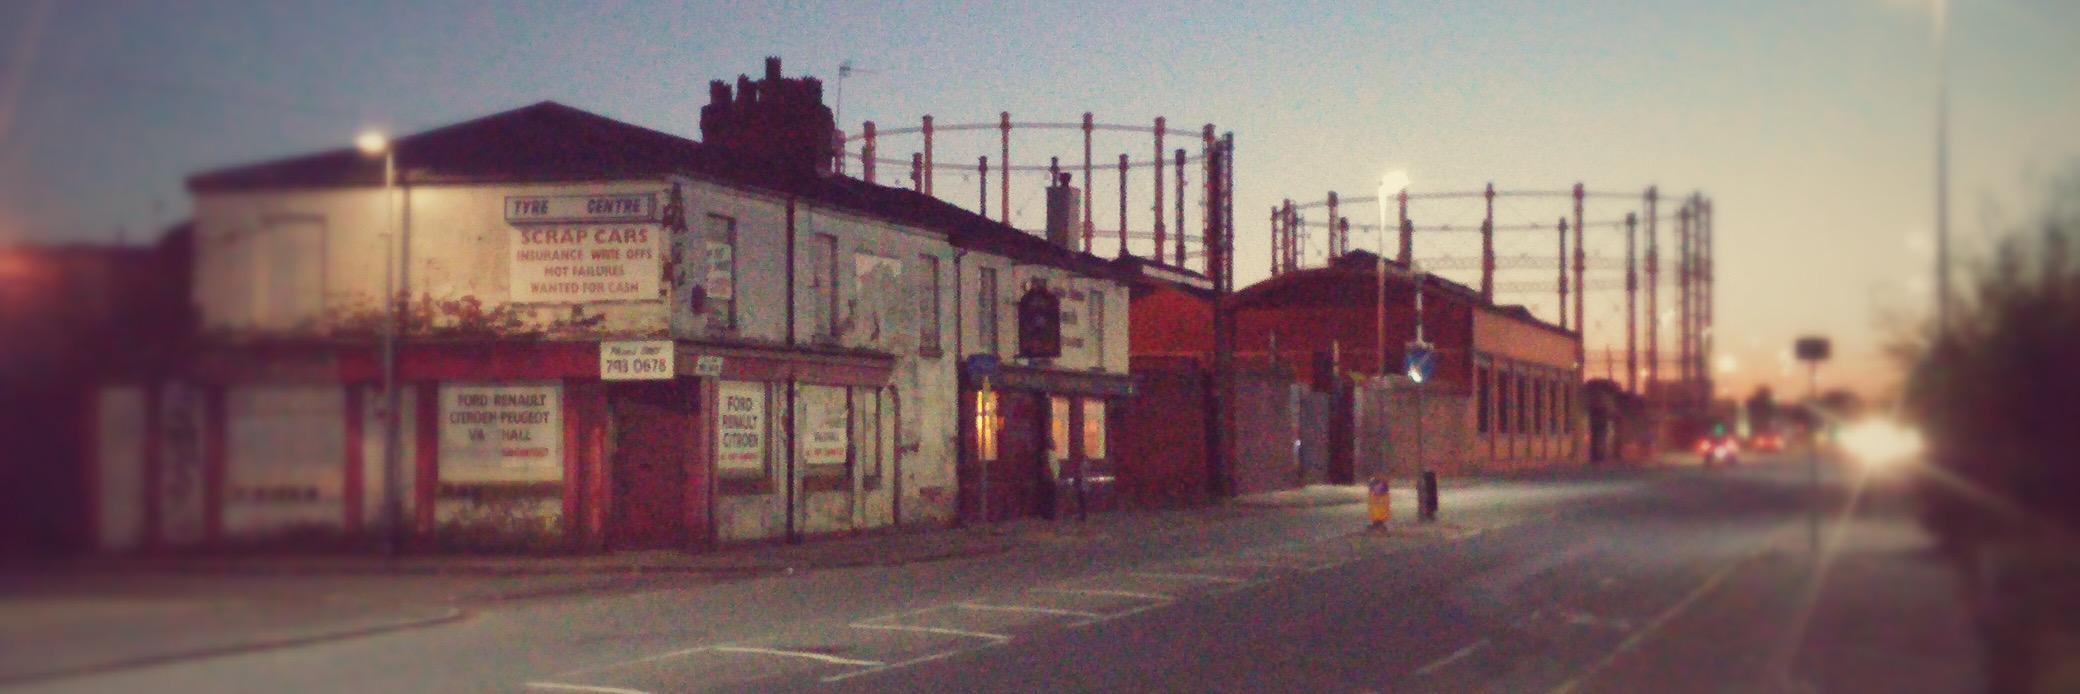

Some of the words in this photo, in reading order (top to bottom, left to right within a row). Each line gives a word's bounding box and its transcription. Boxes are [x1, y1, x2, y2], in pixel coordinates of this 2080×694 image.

[514, 200, 549, 214] TYRE
[587, 199, 641, 214] CENTRE
[521, 229, 588, 244] SCRAP
[594, 228, 648, 244] CARS
[517, 249, 583, 261] INSURANCE
[591, 249, 620, 260] WRITE
[626, 248, 652, 260] OFFS
[572, 265, 625, 277] FAILURES
[530, 282, 579, 293] WANTED
[583, 282, 604, 293] FOR
[609, 282, 639, 293] CASH
[457, 394, 488, 406] FORD
[494, 394, 547, 406] RENAULT
[727, 396, 753, 411] FORD
